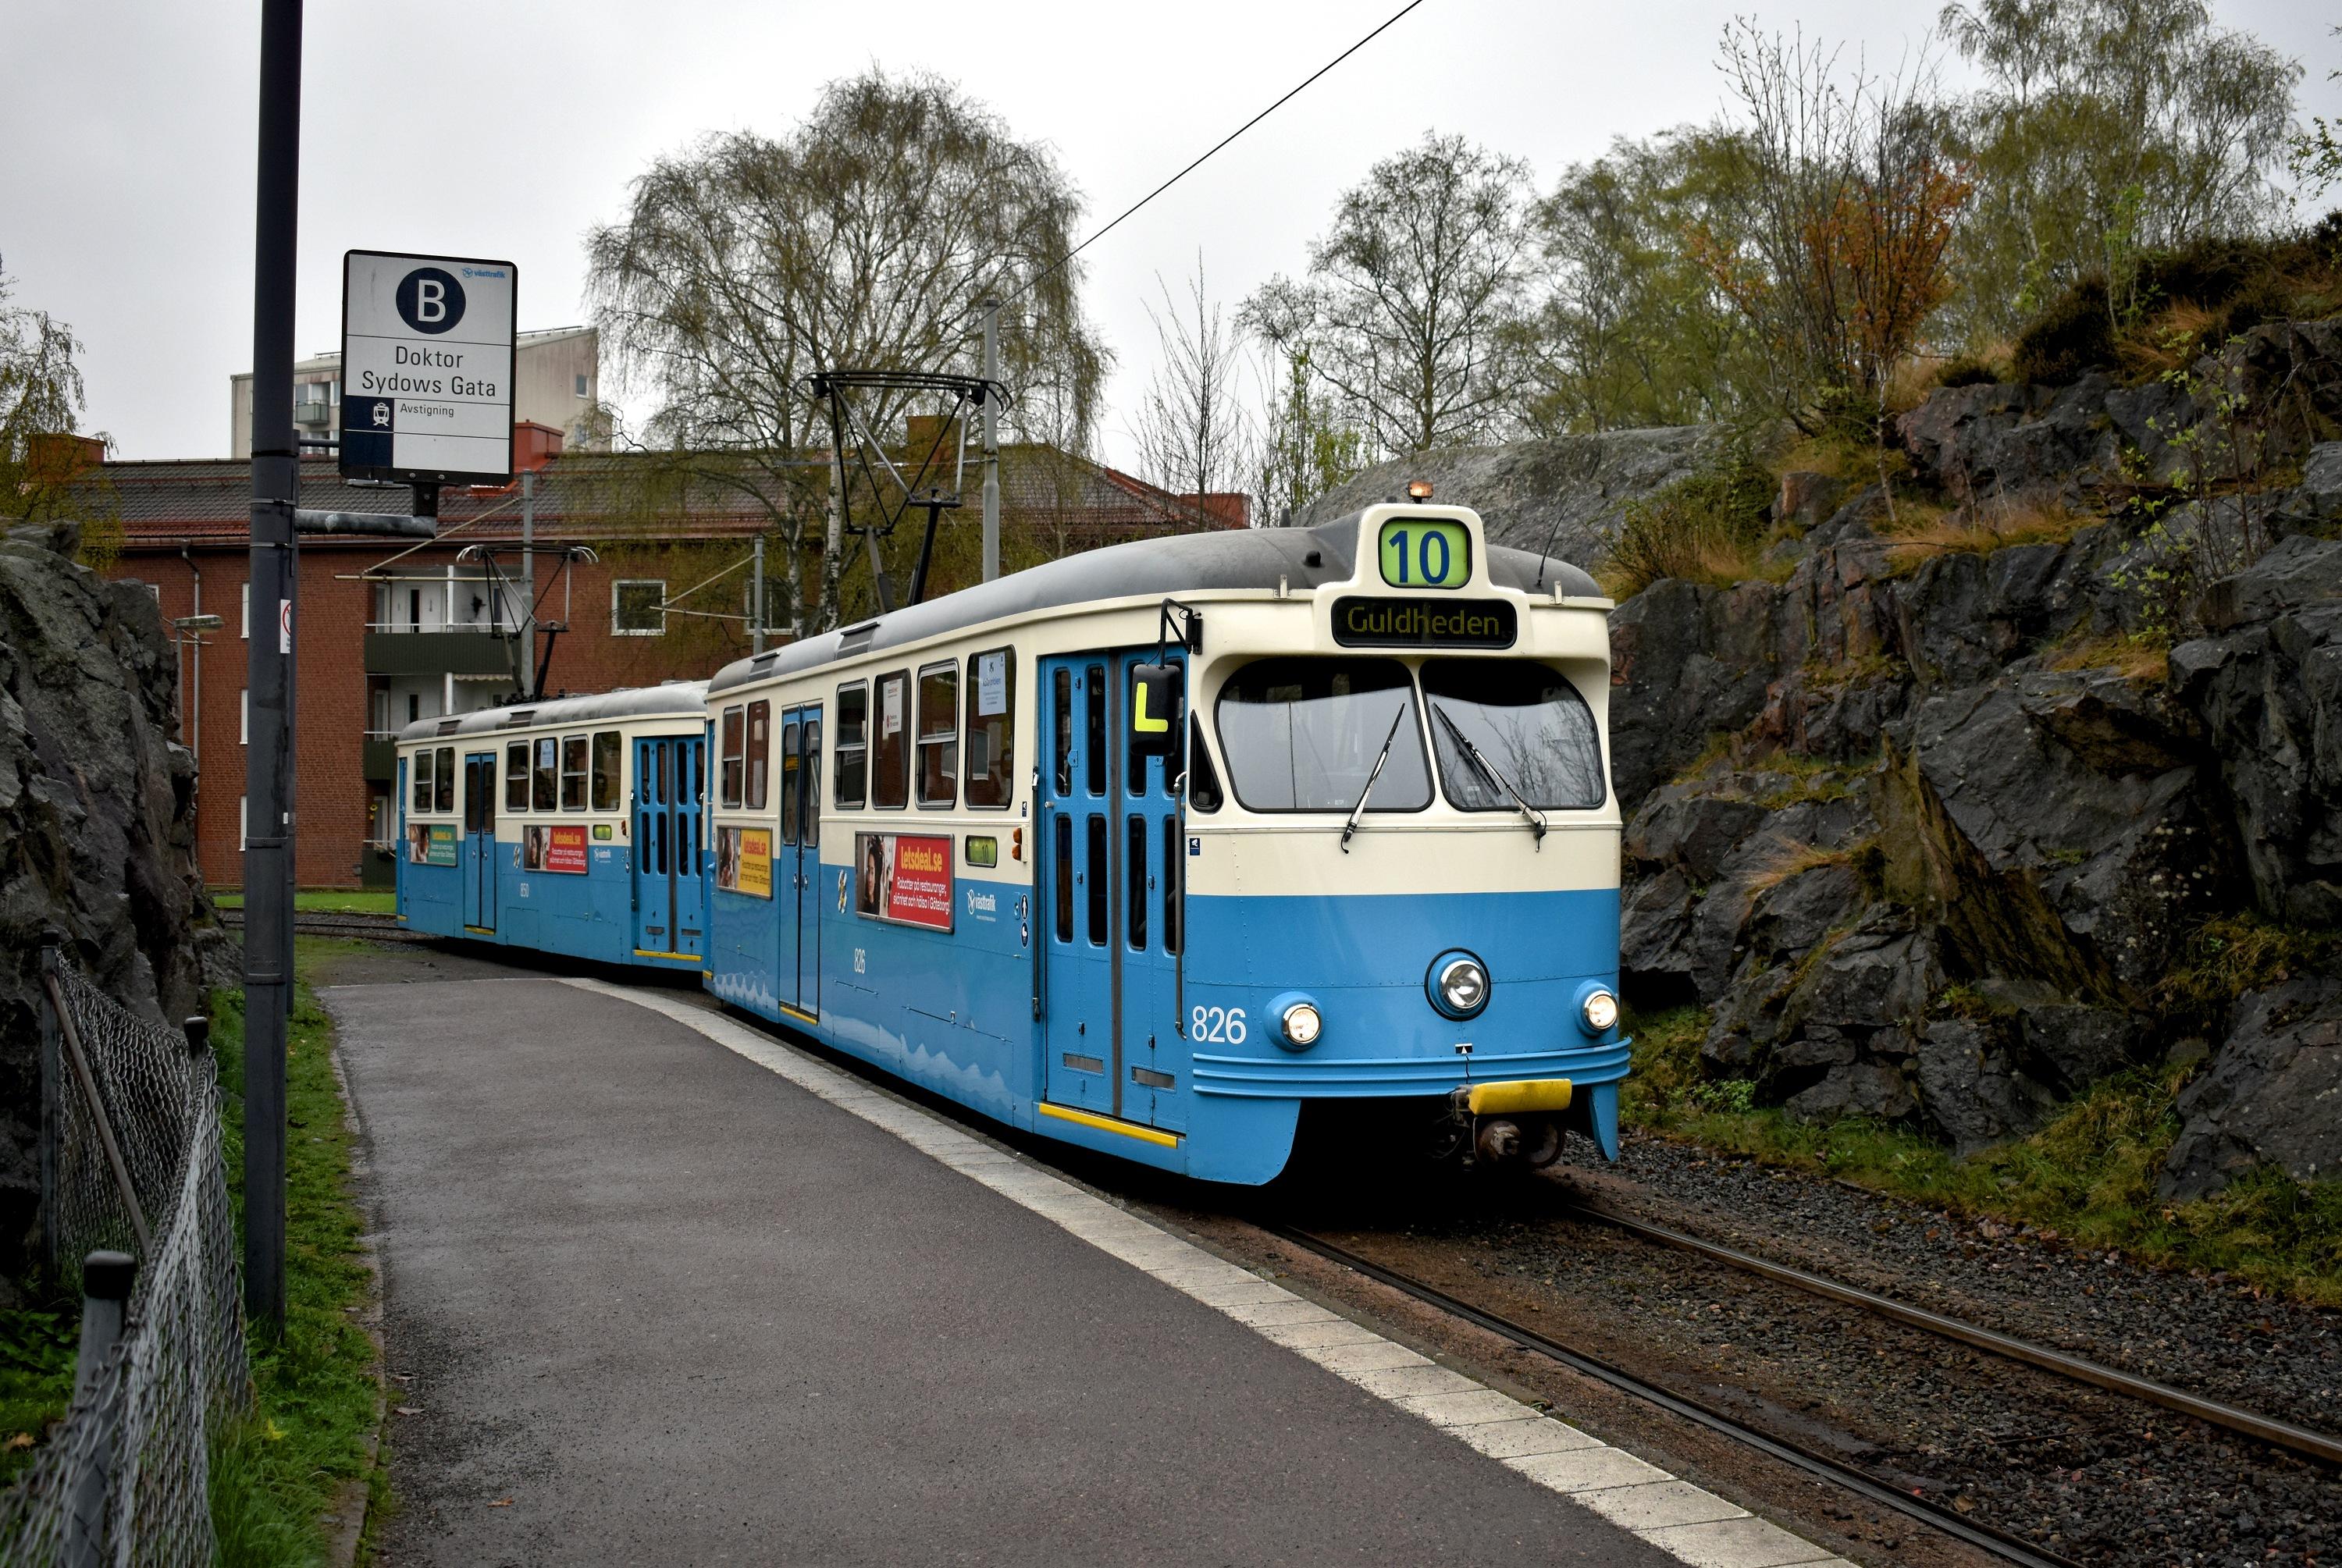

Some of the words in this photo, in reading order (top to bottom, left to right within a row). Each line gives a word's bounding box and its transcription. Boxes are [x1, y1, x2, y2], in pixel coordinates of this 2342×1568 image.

[418, 279, 446, 322] B
[395, 346, 463, 368] Doktor
[361, 370, 442, 394] Sydows
[450, 375, 496, 397] Gata
[400, 403, 454, 418] Avstigning
[1388, 530, 1450, 585] 10
[1347, 606, 1500, 635] Guldheden
[900, 846, 943, 873] letsdeal.se
[913, 877, 920, 894] på
[975, 893, 996, 912] västtrafik
[854, 948, 866, 974] 826
[1191, 1005, 1247, 1044] 826
